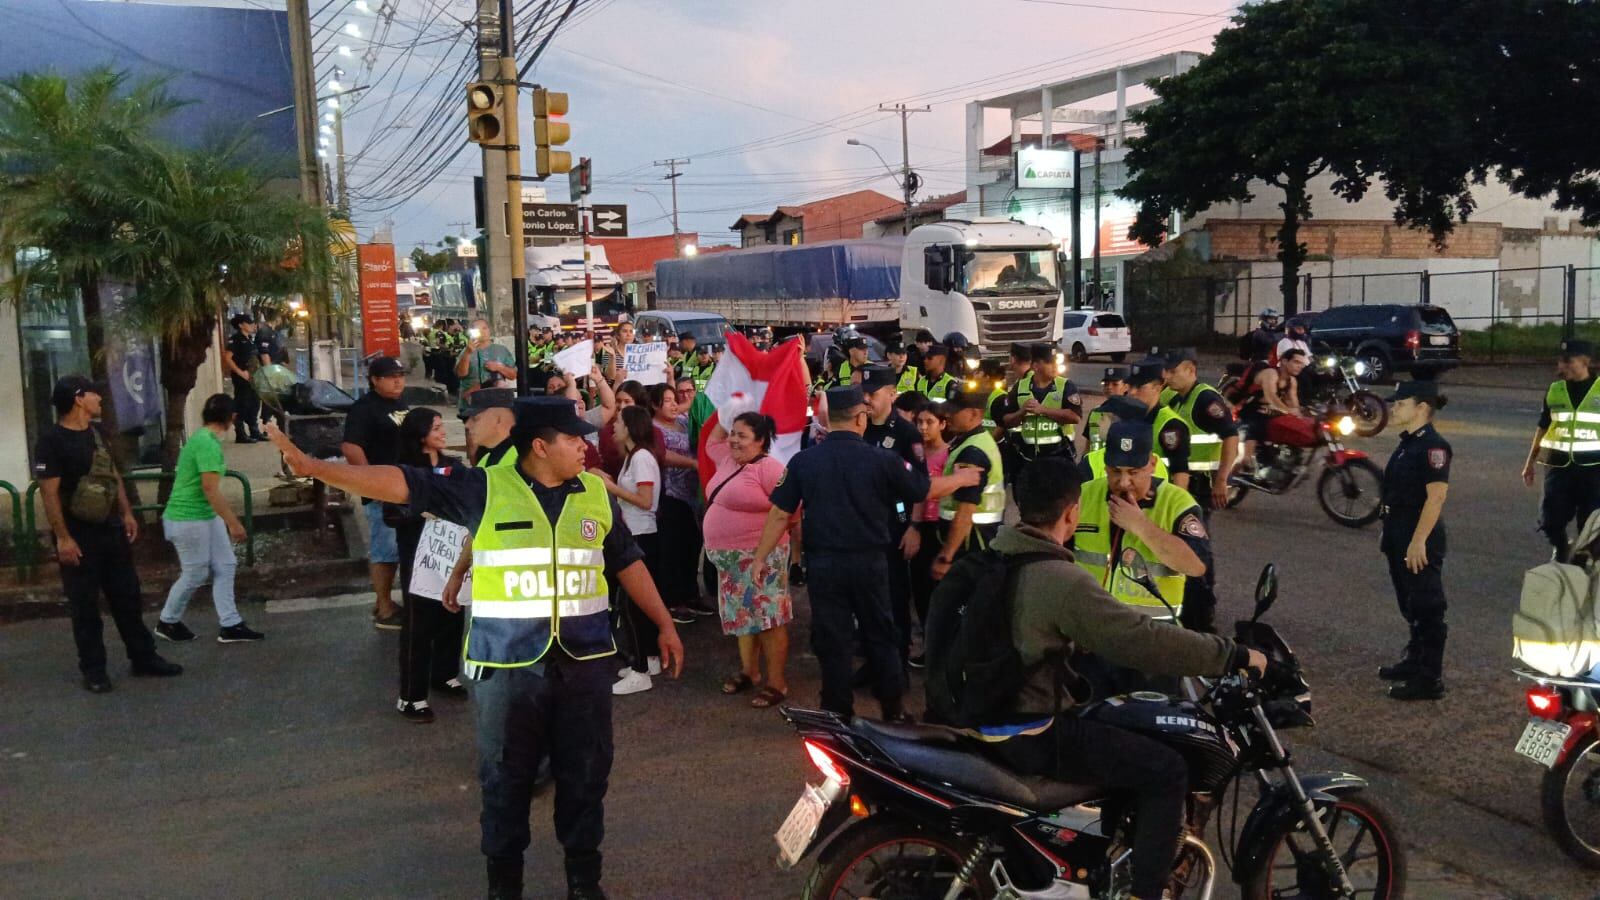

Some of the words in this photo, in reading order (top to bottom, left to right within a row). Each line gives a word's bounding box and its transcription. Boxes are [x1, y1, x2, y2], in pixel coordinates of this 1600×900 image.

[536, 209, 567, 217] Carlos
[522, 221, 546, 230] tonio
[548, 220, 576, 231] López
[998, 300, 1037, 310] SCANIA
[433, 520, 447, 537] EN
[448, 530, 457, 547] EL
[503, 569, 597, 598] POLICIA
[1155, 715, 1217, 733] KENTON
[1528, 724, 1554, 746] 565
